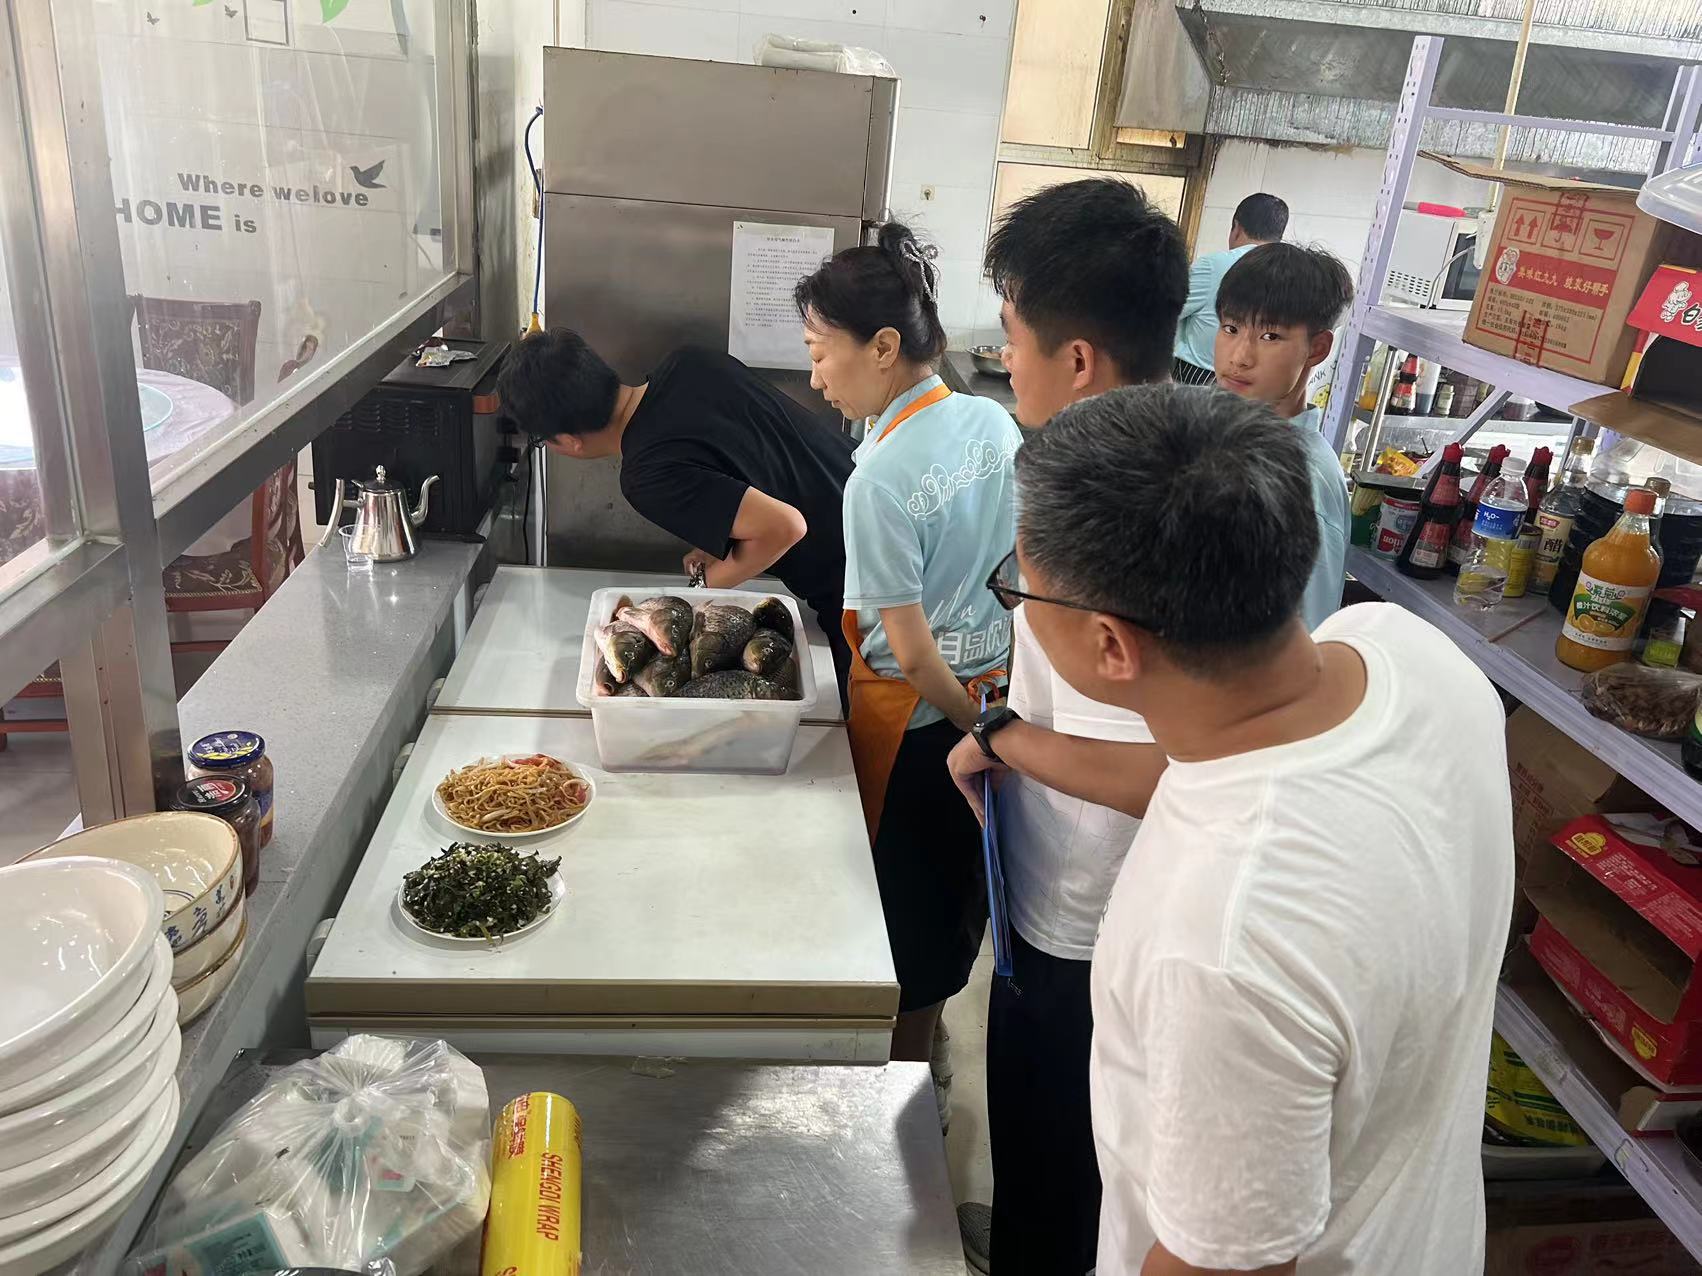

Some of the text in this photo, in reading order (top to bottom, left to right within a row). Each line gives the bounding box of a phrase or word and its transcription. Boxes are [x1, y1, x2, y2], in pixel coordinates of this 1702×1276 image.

[177, 172, 264, 198] Where
[115, 198, 257, 234] HOME is
[1543, 537, 1563, 553] 醋
[536, 1204, 561, 1242] WRAP
